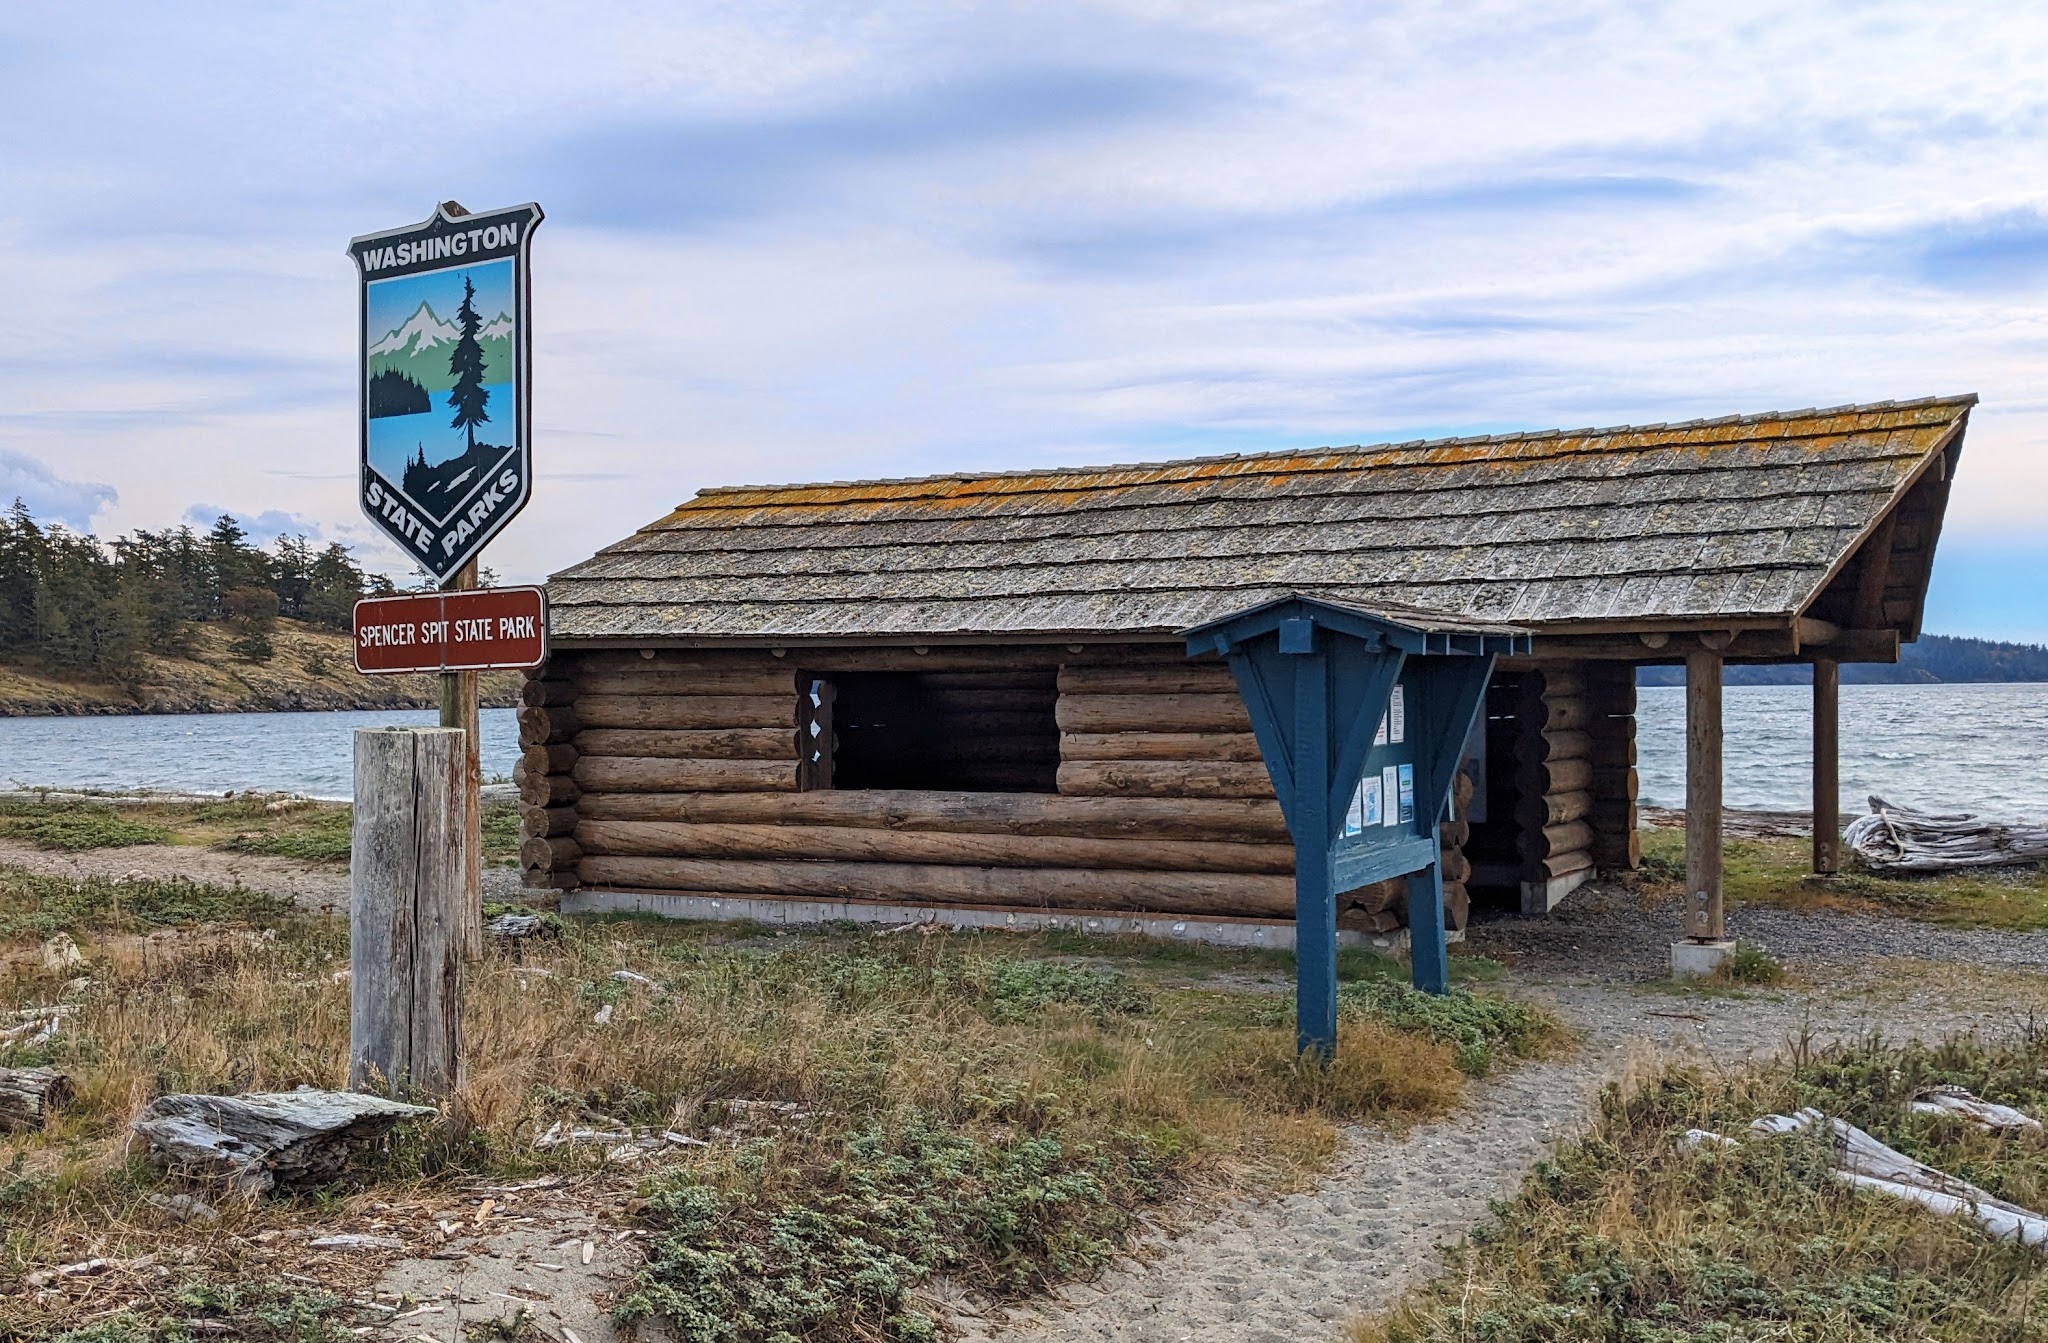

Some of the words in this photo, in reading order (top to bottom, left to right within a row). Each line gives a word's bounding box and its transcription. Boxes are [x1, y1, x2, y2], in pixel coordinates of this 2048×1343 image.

[362, 222, 518, 272] WASHINGTON
[366, 482, 435, 554] STATE
[440, 468, 519, 557] PARKS
[359, 623, 416, 648] SPENCER
[421, 621, 450, 644] SPIT
[454, 618, 493, 643] STATE
[499, 616, 536, 640] PARK
